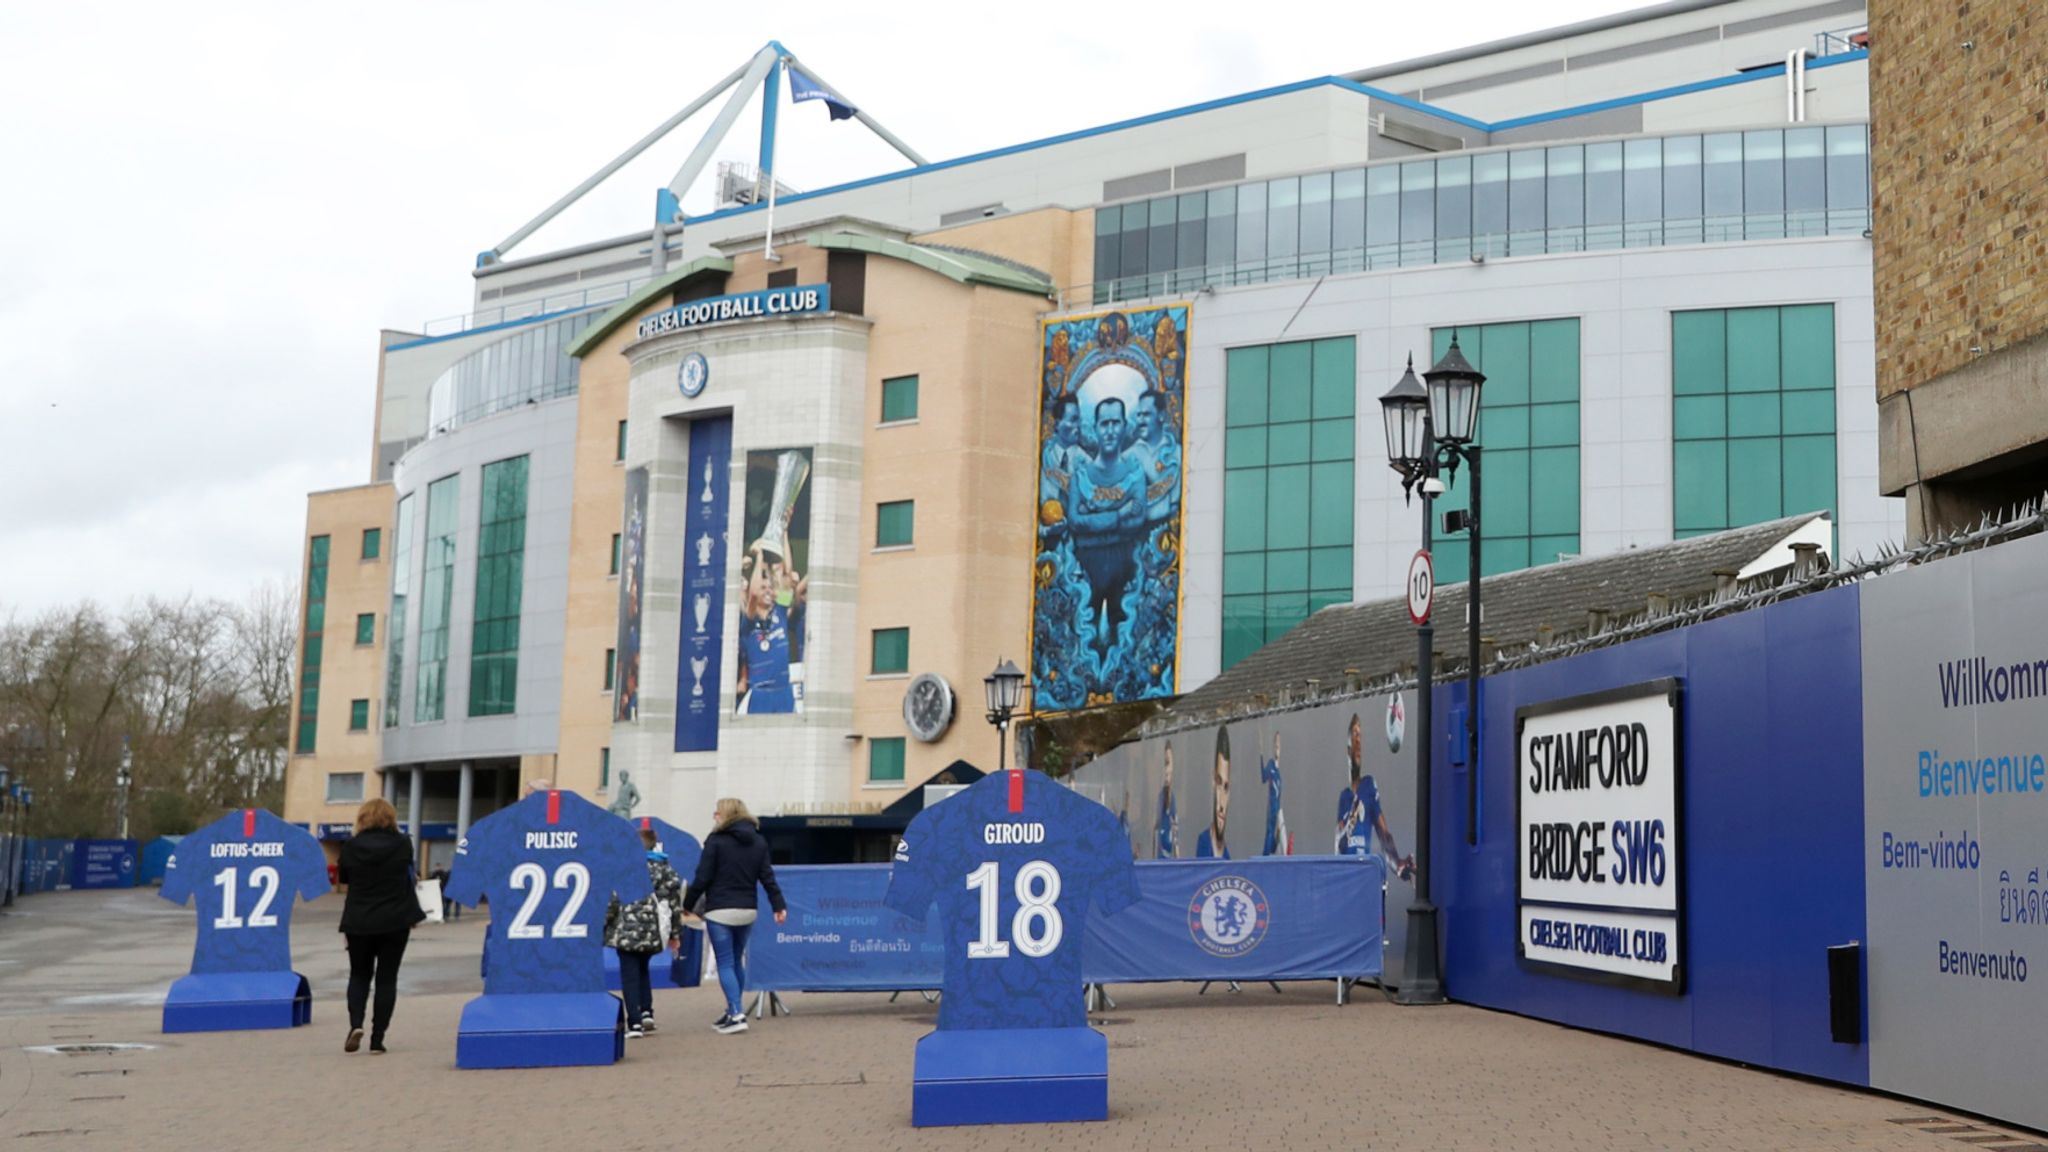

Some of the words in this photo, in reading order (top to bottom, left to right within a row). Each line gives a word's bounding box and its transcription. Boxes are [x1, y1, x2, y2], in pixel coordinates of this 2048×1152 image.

[637, 311, 680, 338] CHELSEA
[681, 296, 763, 326] FOOTBALL
[767, 289, 818, 314] CLUB
[1413, 571, 1428, 602] 10
[1529, 722, 1649, 793] STAMFORD
[1918, 750, 2045, 798] Bienvenue
[783, 802, 882, 815] MILLENNIUM
[210, 842, 285, 858] LOFTUS-CHEEK
[525, 831, 579, 850] PULISIC
[984, 823, 1045, 844] GIROUD
[1529, 821, 1605, 883] BRIDGE
[1611, 819, 1666, 887] SW6
[1882, 830, 1980, 870] Bem-vindo
[214, 865, 280, 929] 12
[507, 861, 591, 939] 22
[1203, 879, 1254, 897] CHELSEA
[802, 913, 879, 926] Bienvenue
[966, 860, 1063, 959] 18
[776, 932, 840, 944] Bem-vindo
[1529, 918, 1573, 951] CHELSEA
[1574, 923, 1632, 960] FOOTBALL
[1633, 929, 1667, 963] CLUB
[1939, 940, 2027, 983] Benvenuto
